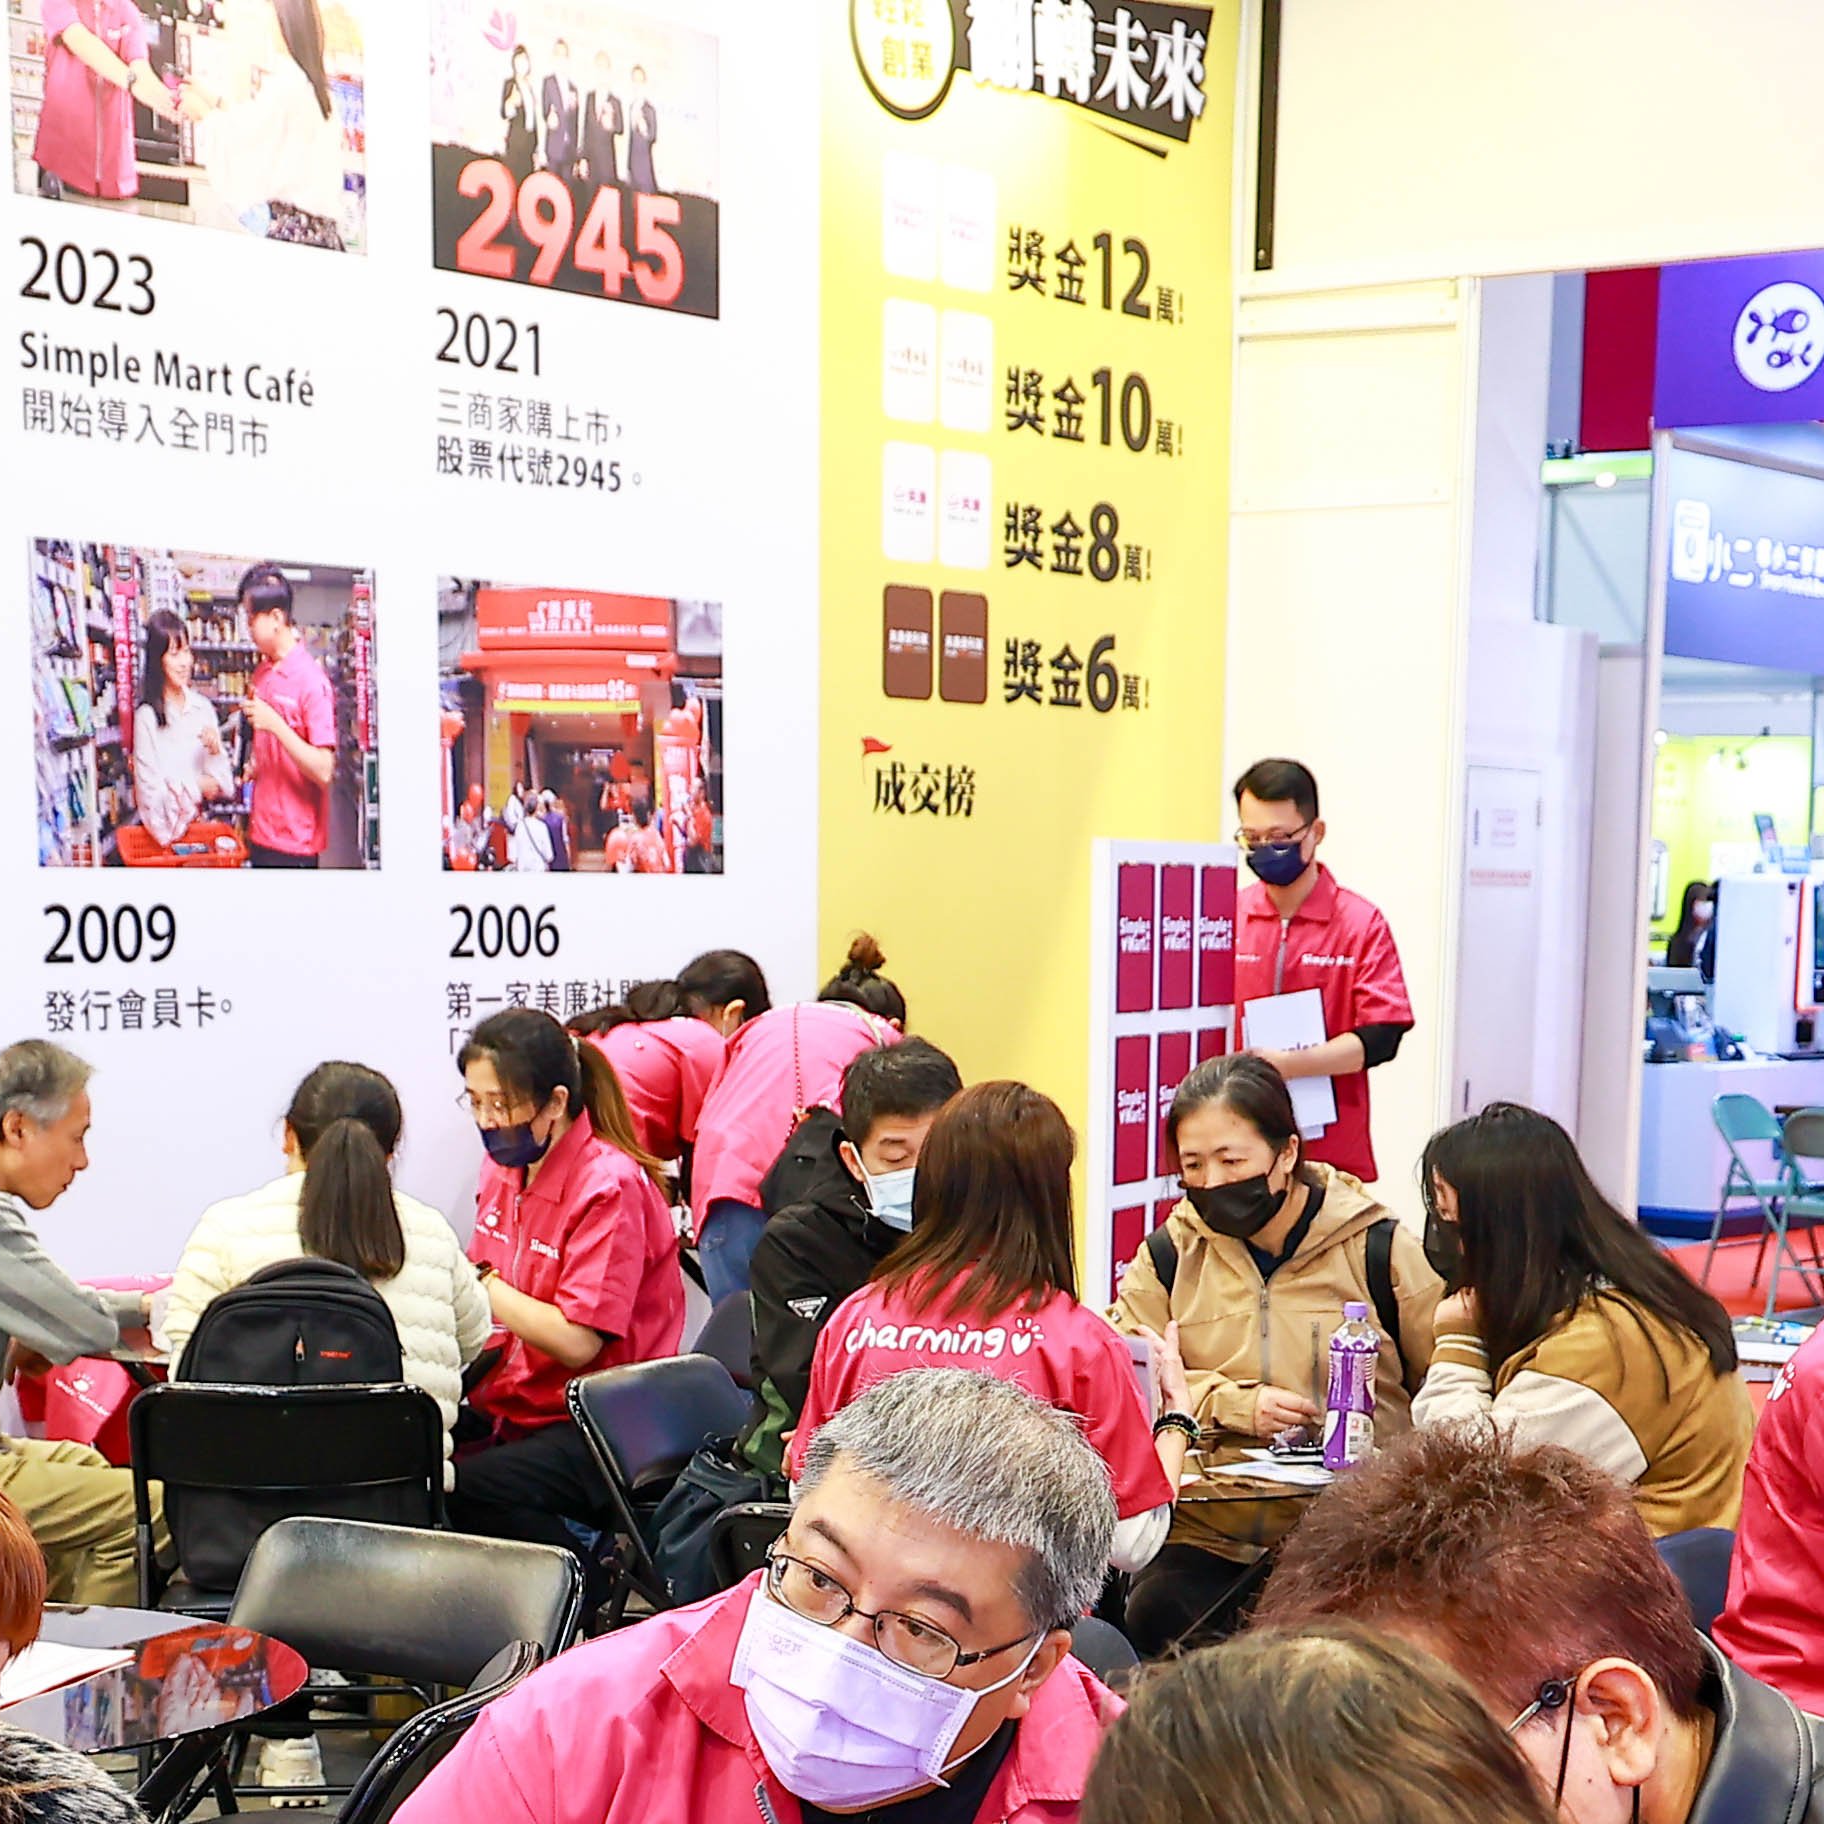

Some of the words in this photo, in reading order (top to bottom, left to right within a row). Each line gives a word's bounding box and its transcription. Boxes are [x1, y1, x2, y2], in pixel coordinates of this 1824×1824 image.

[456, 158, 685, 305] 2945
[19, 236, 157, 316] 2023
[21, 332, 141, 387] Simple
[154, 351, 233, 396] Mart
[244, 365, 315, 407] Café
[435, 307, 542, 377] 2021
[22, 387, 269, 457] 開始導入全門市
[436, 388, 623, 446] 三商家購上市，
[436, 435, 642, 493] 股票代號2945。
[873, 761, 976, 818] 成交榜
[43, 904, 177, 964] 2009
[449, 903, 561, 959] 2006
[44, 987, 232, 1033] 發行會員卡。
[844, 1316, 1006, 1359] charming
